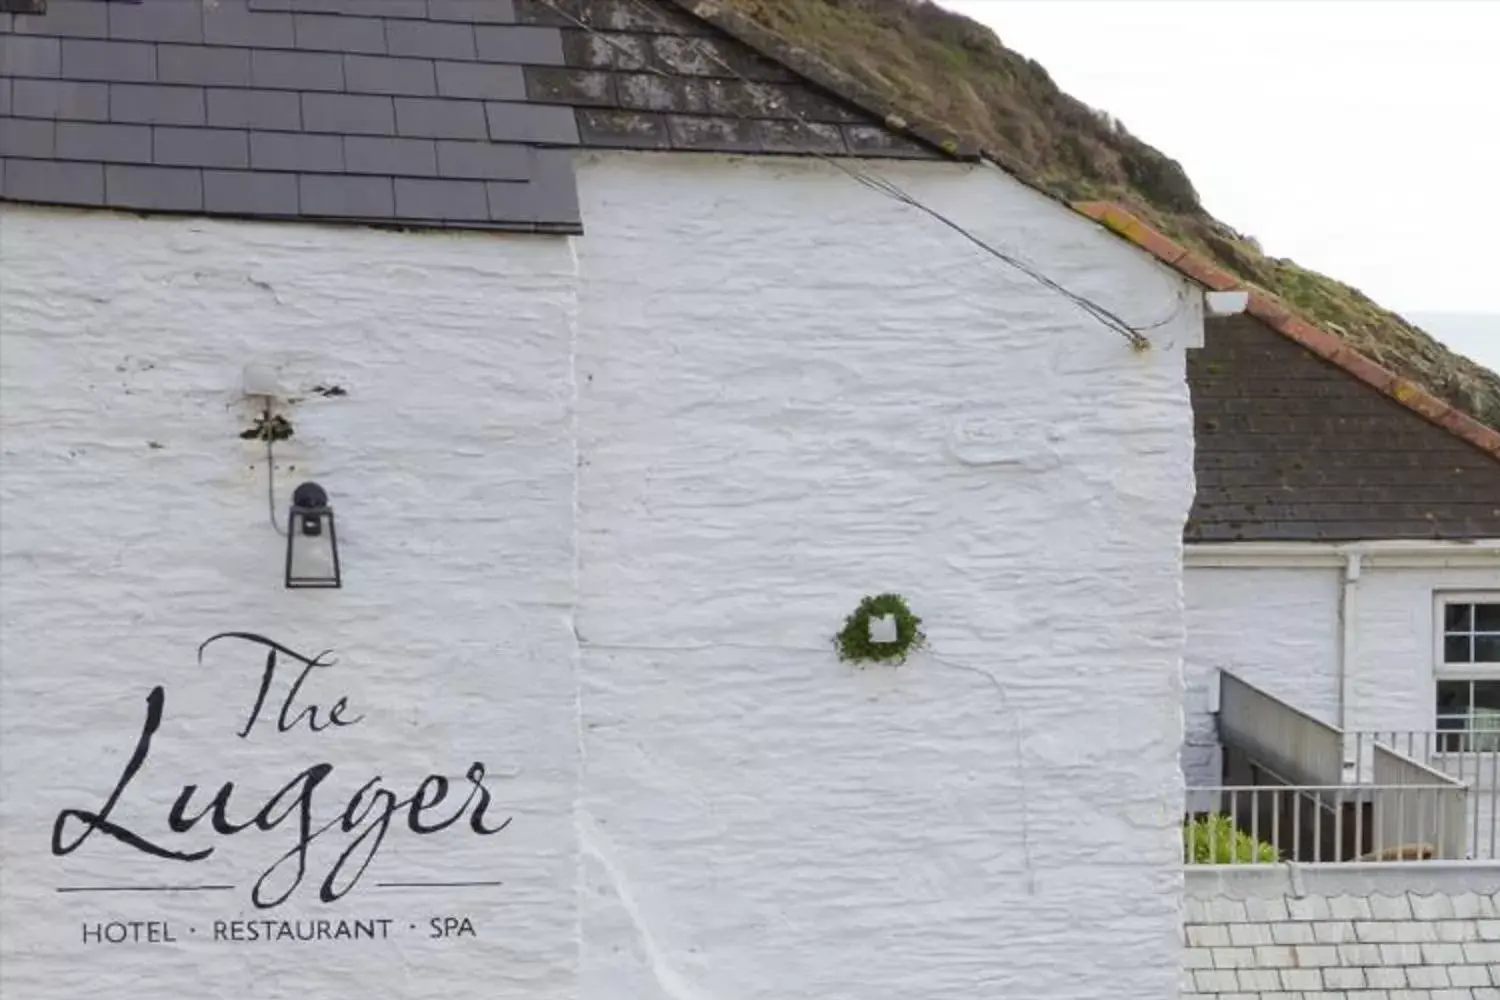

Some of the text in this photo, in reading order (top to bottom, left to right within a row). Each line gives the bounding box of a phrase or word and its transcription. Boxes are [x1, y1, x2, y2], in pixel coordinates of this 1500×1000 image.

[198, 632, 365, 738] The
[52, 686, 512, 909] Lugger
[83, 917, 476, 943] HOTEL RESTAURANT SPA
